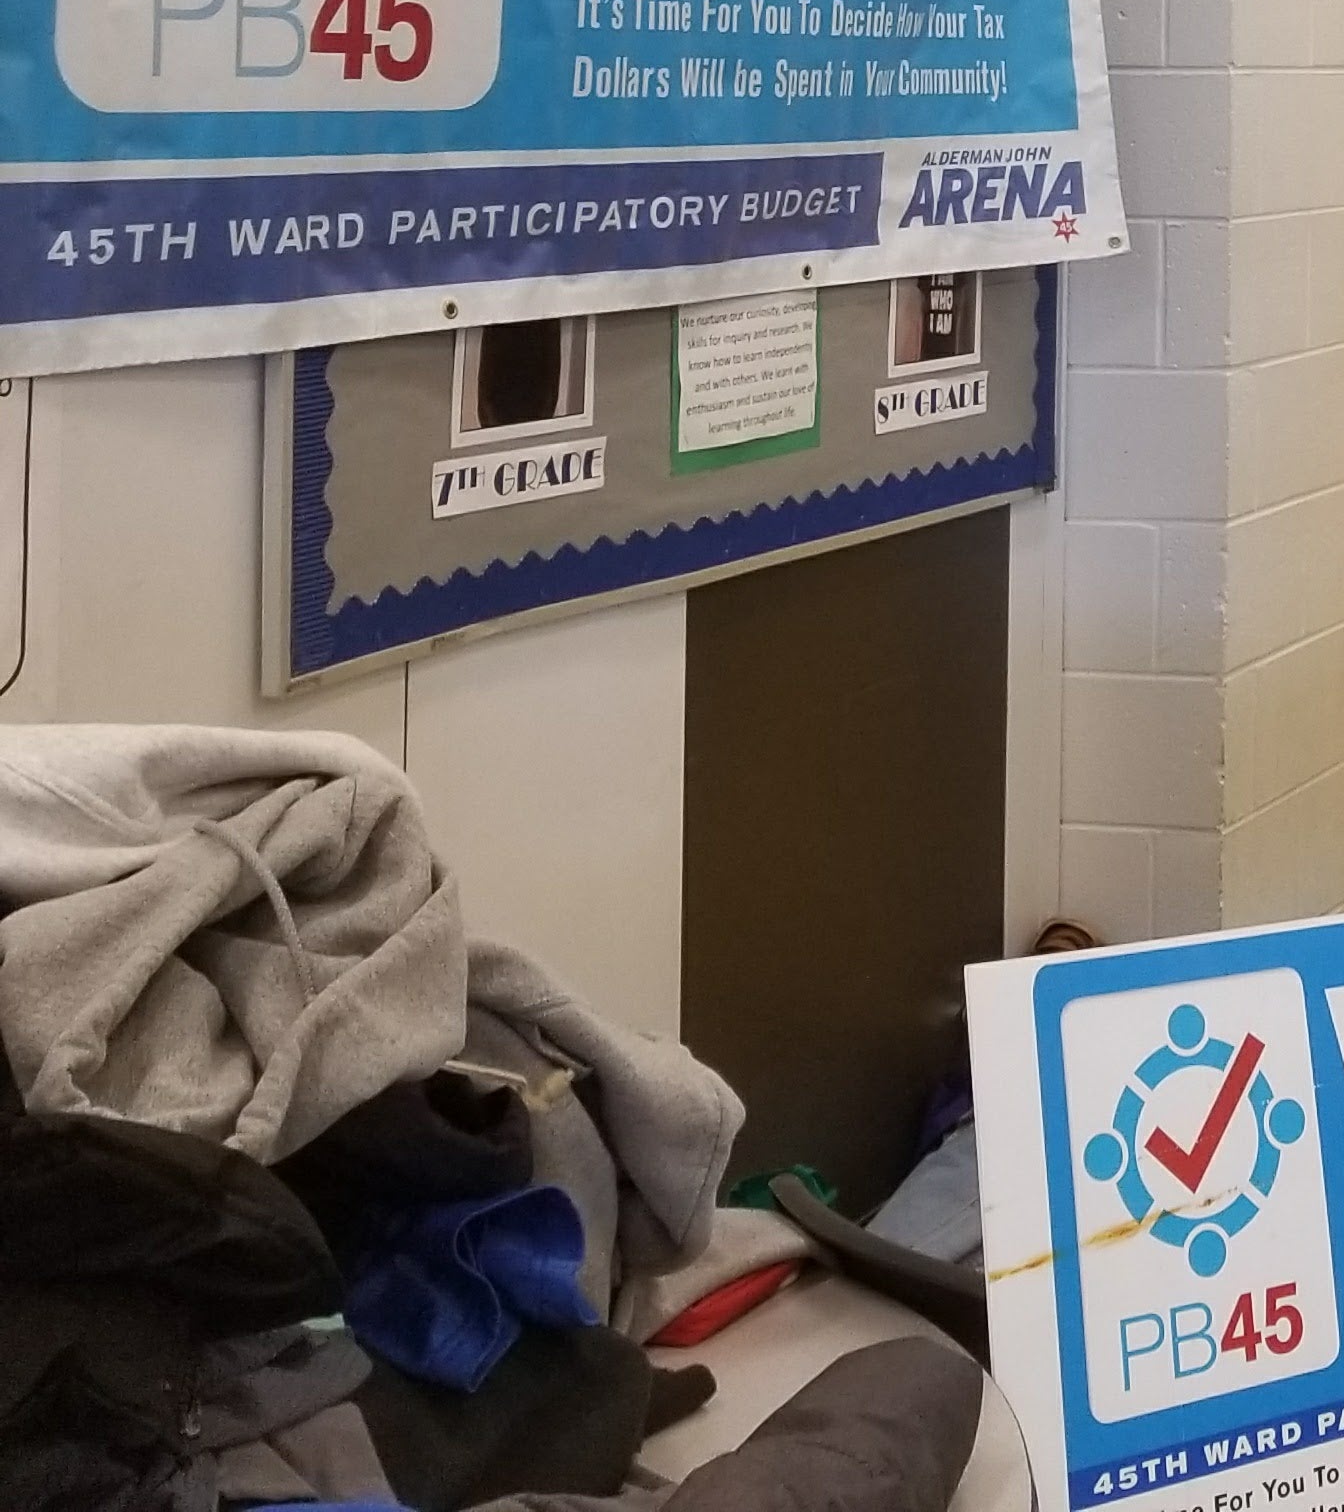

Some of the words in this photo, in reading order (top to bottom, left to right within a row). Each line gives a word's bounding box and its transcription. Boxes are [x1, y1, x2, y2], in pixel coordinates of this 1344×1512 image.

[896, 2, 925, 39] How
[926, 3, 967, 40] Your
[973, 4, 1005, 40] Tax
[572, 55, 670, 100] Dollars
[680, 58, 725, 99] Will
[734, 58, 762, 98] be
[775, 60, 833, 106] Spent
[839, 60, 854, 97] in
[865, 60, 896, 97] Your
[898, 59, 1008, 103] Community!
[922, 148, 1003, 167] ALDERMAN
[1004, 146, 1052, 164] JOHN
[899, 161, 1087, 230] ARENA
[47, 221, 197, 267] 45TH
[228, 212, 365, 256] WARD
[388, 193, 725, 247] PARTICIPATORY
[740, 184, 862, 223] BUDGET
[1058, 220, 1073, 234] 45
[930, 289, 954, 311] WHO
[680, 316, 695, 329] We
[696, 313, 728, 327] nurture
[729, 311, 745, 323] our
[936, 313, 953, 335] AM
[687, 335, 708, 350] skills
[709, 333, 722, 346] for
[722, 331, 752, 346] inquiry
[753, 327, 769, 340] and
[688, 359, 712, 372] know
[713, 356, 731, 370] how
[732, 354, 742, 365] to
[742, 351, 763, 364] learn
[694, 379, 711, 393] and
[713, 376, 731, 390] with
[760, 370, 774, 382] We
[775, 365, 794, 379] learn
[686, 399, 736, 417] enthusiasm
[736, 395, 751, 409] and
[752, 390, 778, 404] sustain
[778, 387, 793, 399] our
[914, 378, 987, 418] GRADE
[708, 417, 742, 435] learning
[743, 410, 783, 428] throughout
[493, 446, 603, 497] GRADE
[1118, 1282, 1305, 1392] PB45
[1092, 1451, 1188, 1496] 45TH
[1203, 1421, 1302, 1467] WARD
[1213, 1491, 1254, 1512] For
[1262, 1475, 1307, 1503] You
[1314, 1464, 1340, 1489] To
